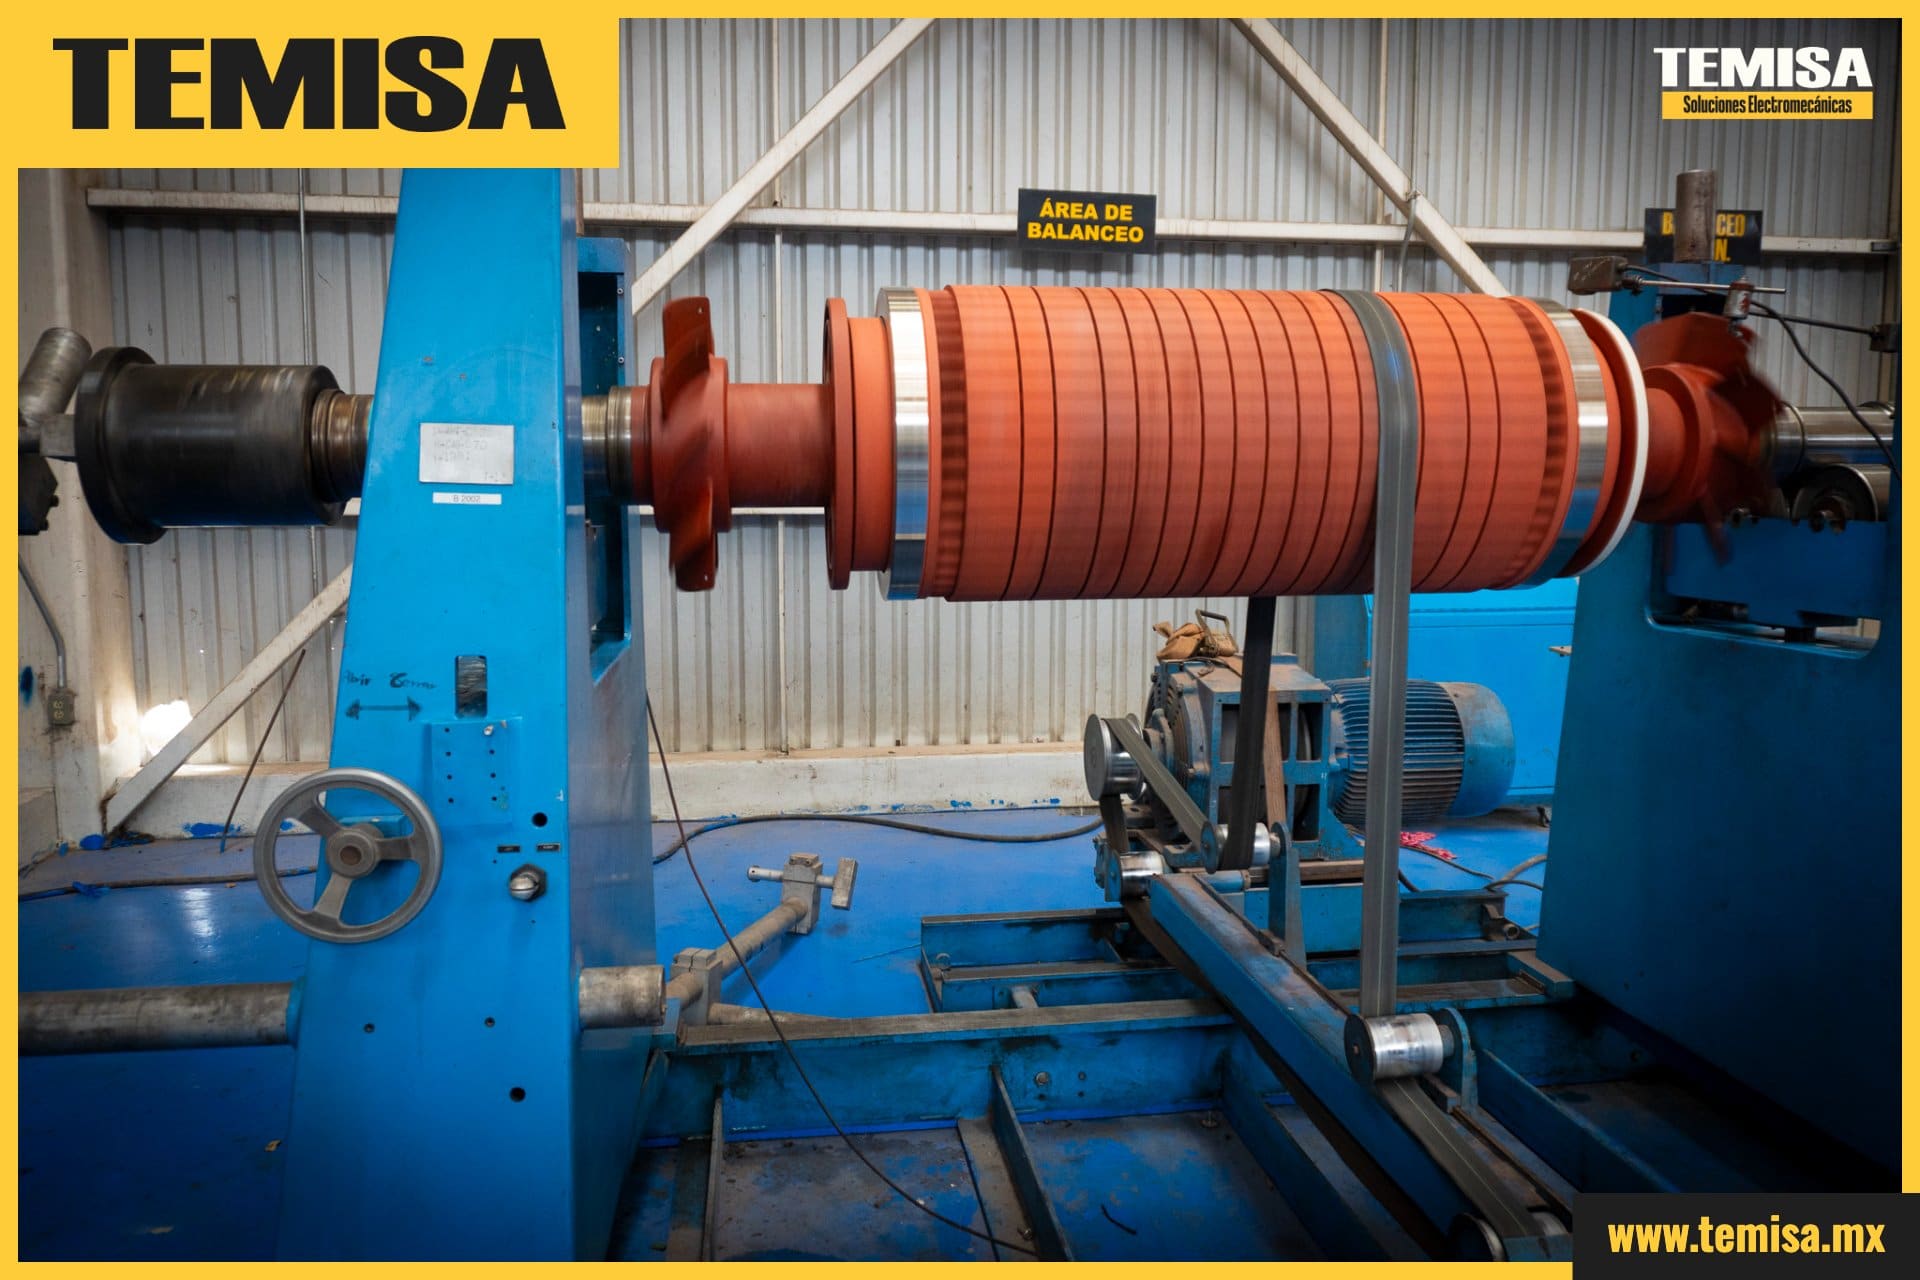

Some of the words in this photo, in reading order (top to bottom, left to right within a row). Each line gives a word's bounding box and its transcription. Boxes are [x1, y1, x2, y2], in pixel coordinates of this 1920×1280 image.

[1039, 197, 1099, 221] ÁREA
[1104, 203, 1133, 222] DE
[1027, 221, 1145, 244] BALANCEO
